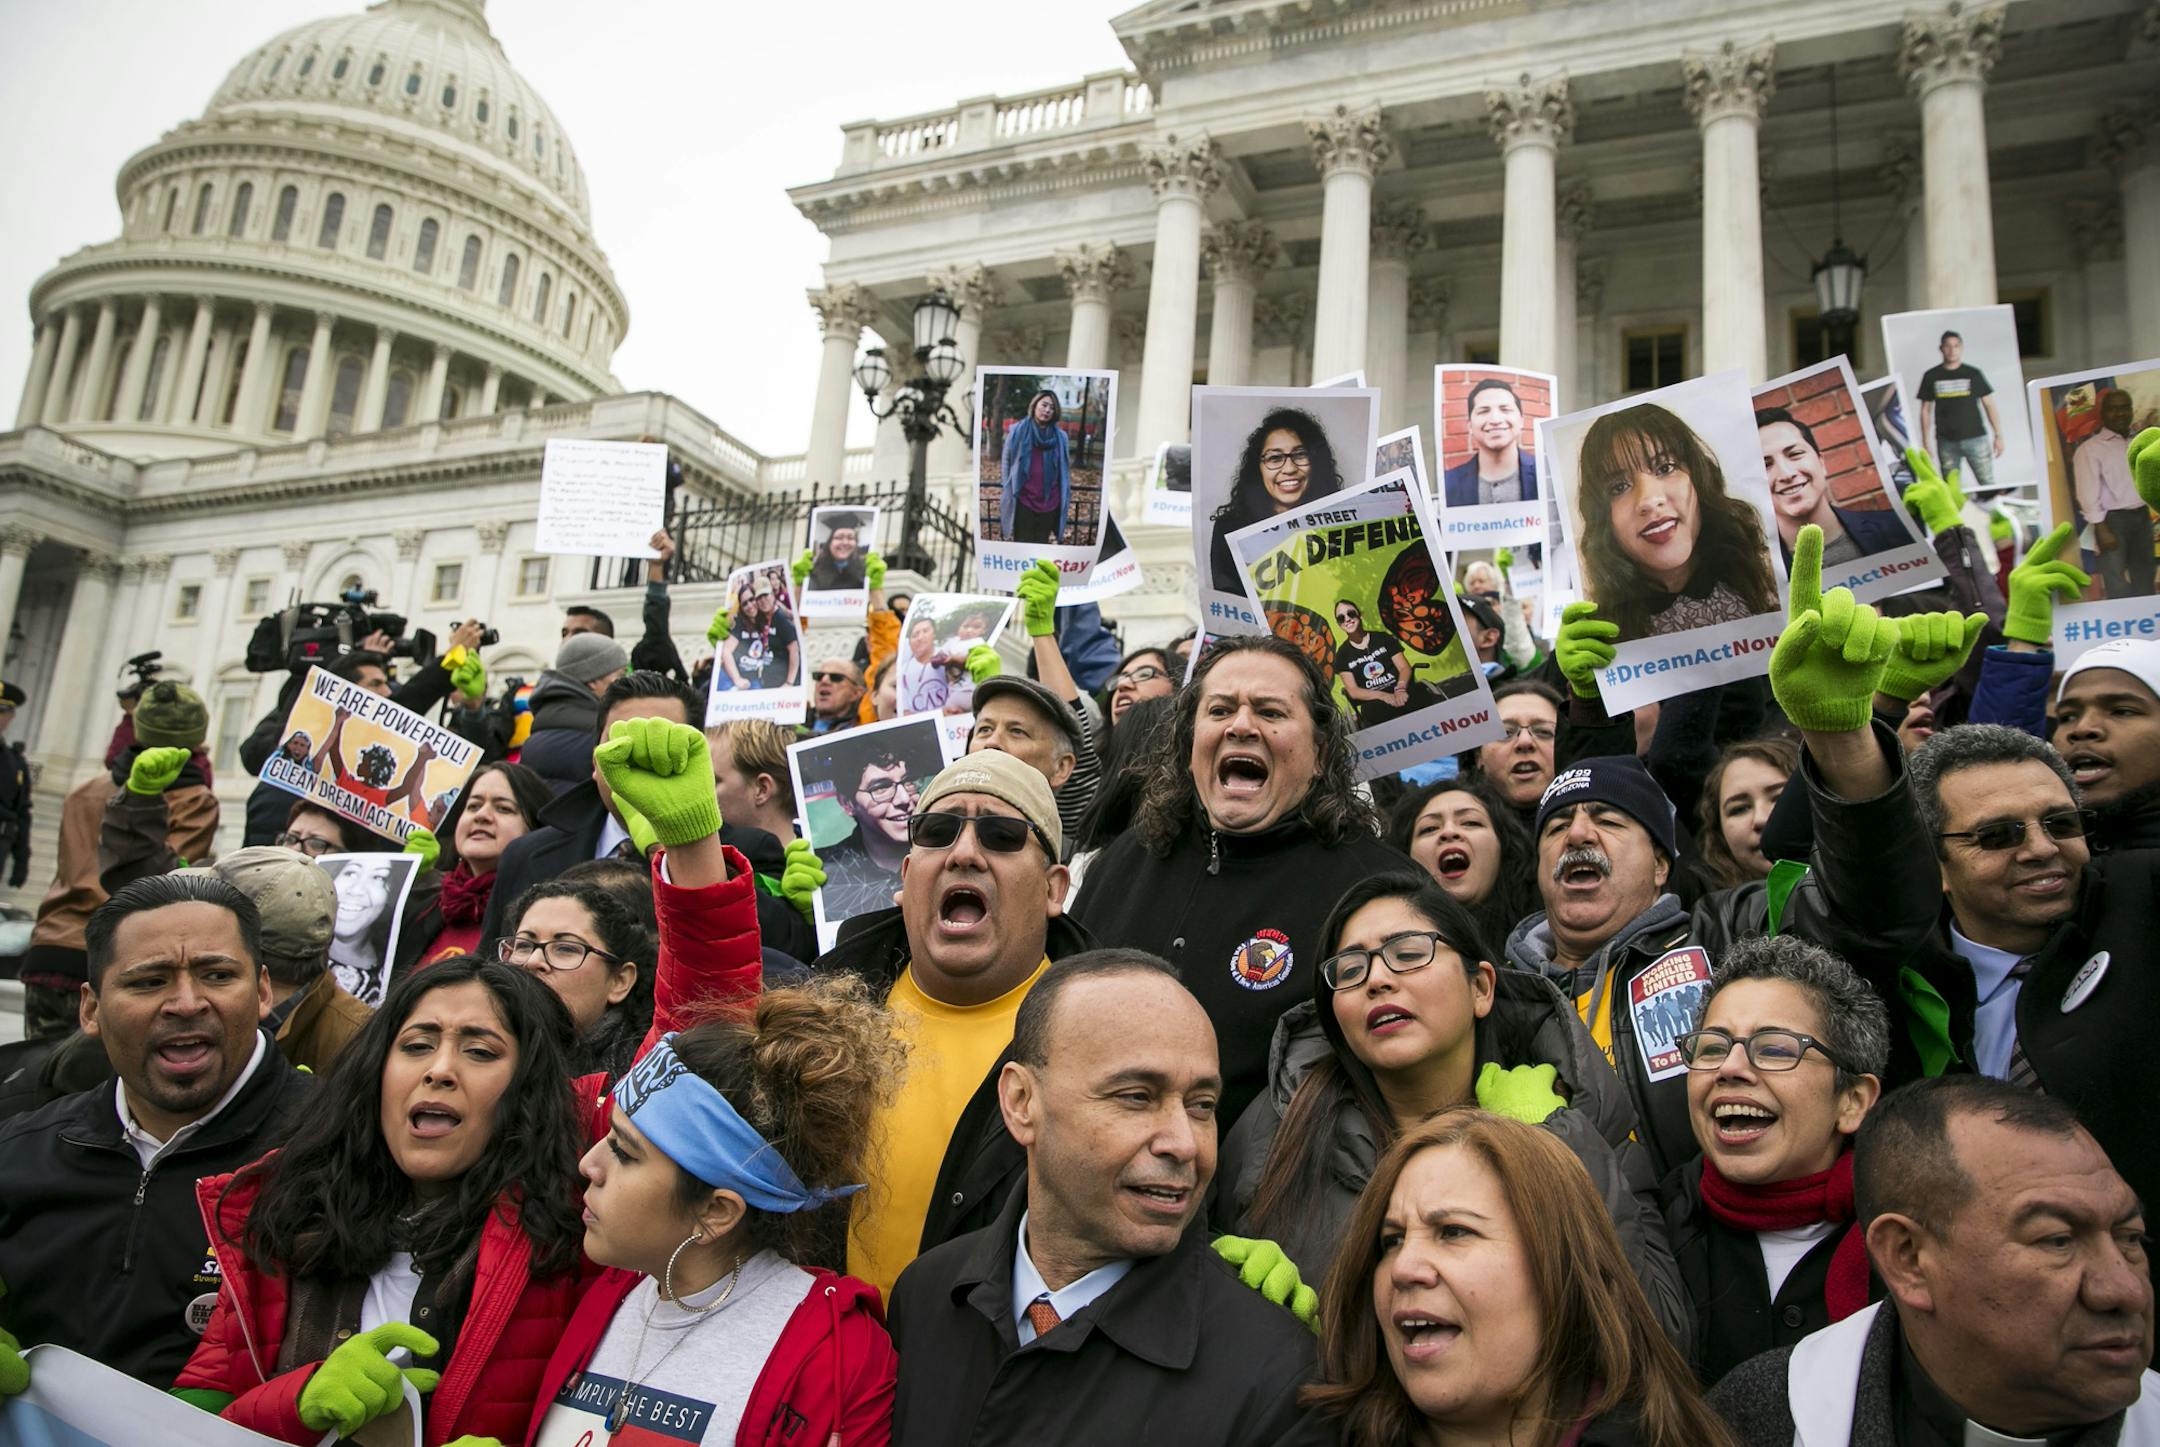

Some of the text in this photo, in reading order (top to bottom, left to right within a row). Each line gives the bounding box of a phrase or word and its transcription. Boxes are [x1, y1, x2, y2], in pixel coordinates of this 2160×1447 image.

[1305, 508, 1359, 527] STREET
[983, 553, 1091, 575] #HereTStay
[2064, 612, 2160, 642] #Here
[313, 673, 471, 766] WE ARE POWERFUL!
[1573, 768, 1592, 778] 99
[269, 758, 423, 841] CLEAN DREAM ACT NO
[1555, 782, 1590, 797] ARIZONA
[1641, 953, 1691, 982] WORKING
[1642, 961, 1694, 988] FAMILIES
[1643, 970, 1697, 997] UNITED
[1651, 1057, 1667, 1069] To
[624, 1392, 649, 1418] HE
[650, 1400, 702, 1432] BEST
